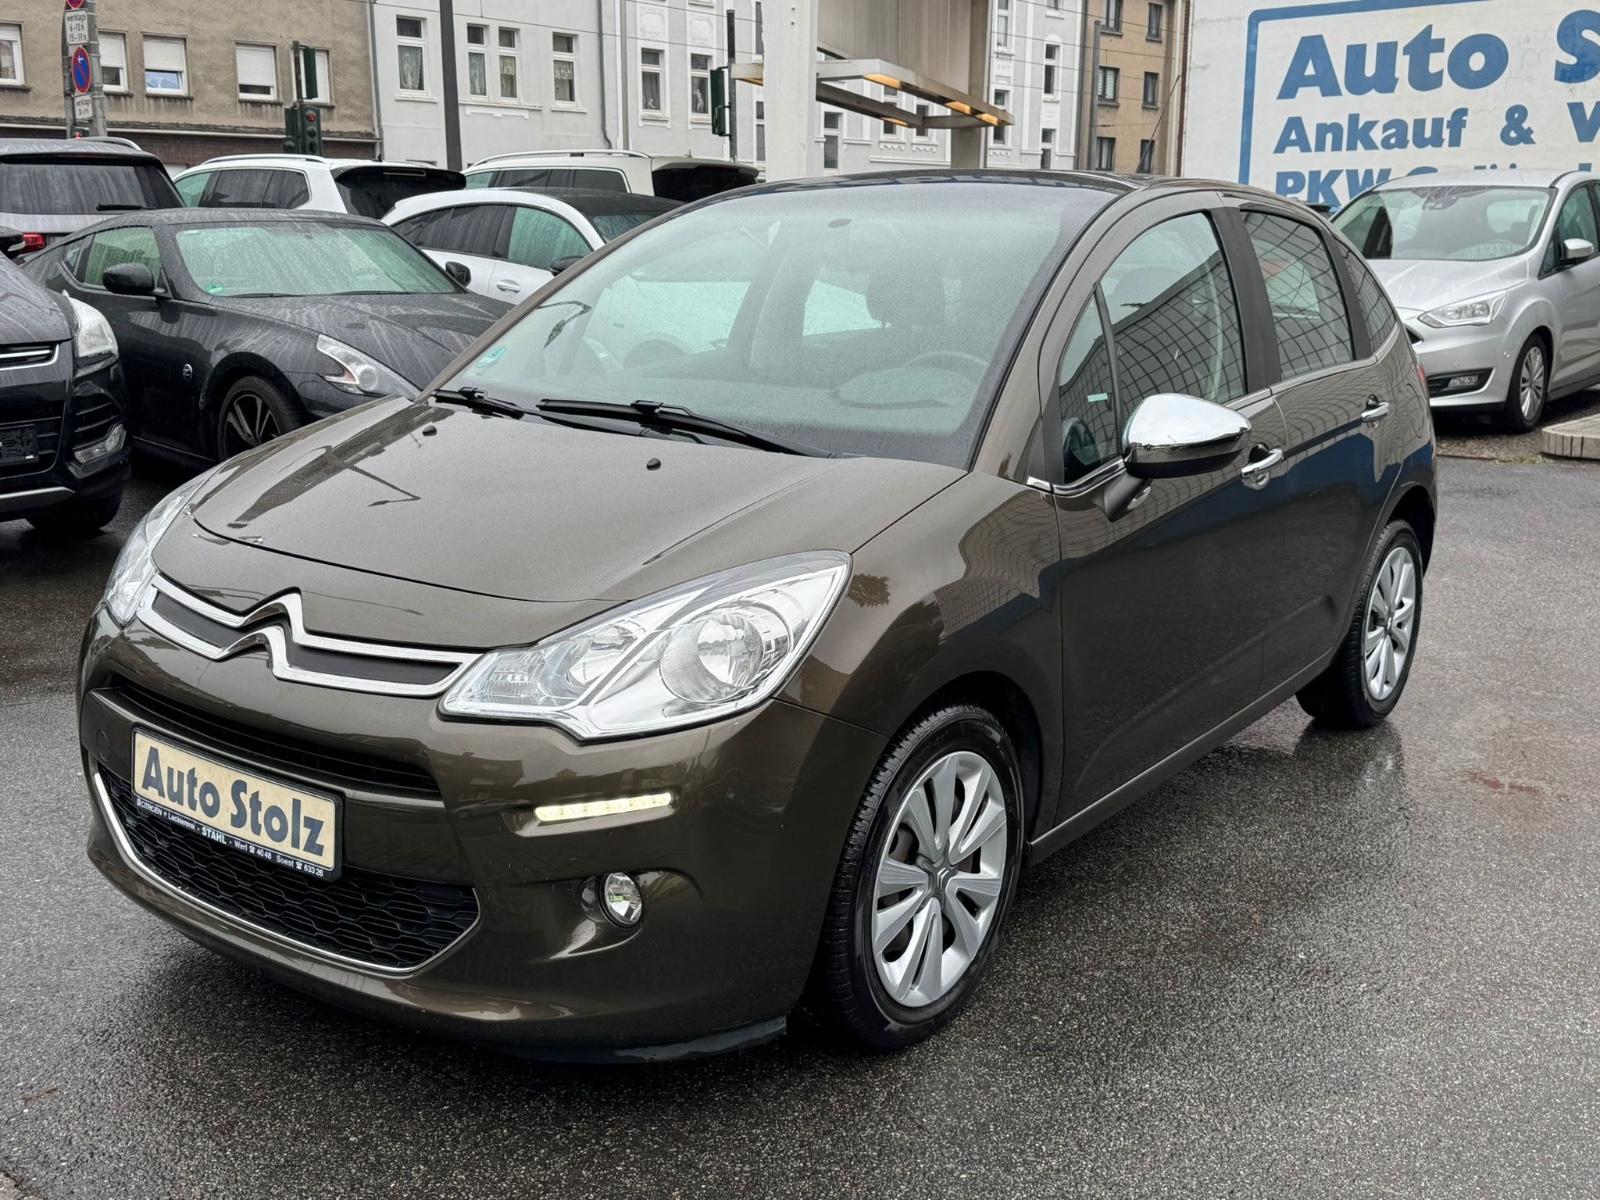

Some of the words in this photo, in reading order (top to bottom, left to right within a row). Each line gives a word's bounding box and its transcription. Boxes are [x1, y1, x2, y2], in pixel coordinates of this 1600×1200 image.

[1276, 24, 1509, 100] Auto
[1273, 107, 1468, 154] Ankauf
[1500, 104, 1536, 146] &
[142, 746, 221, 818] Auto
[230, 779, 325, 857] Stolz
[202, 827, 227, 845] STAHL
[276, 855, 295, 867] Soest
